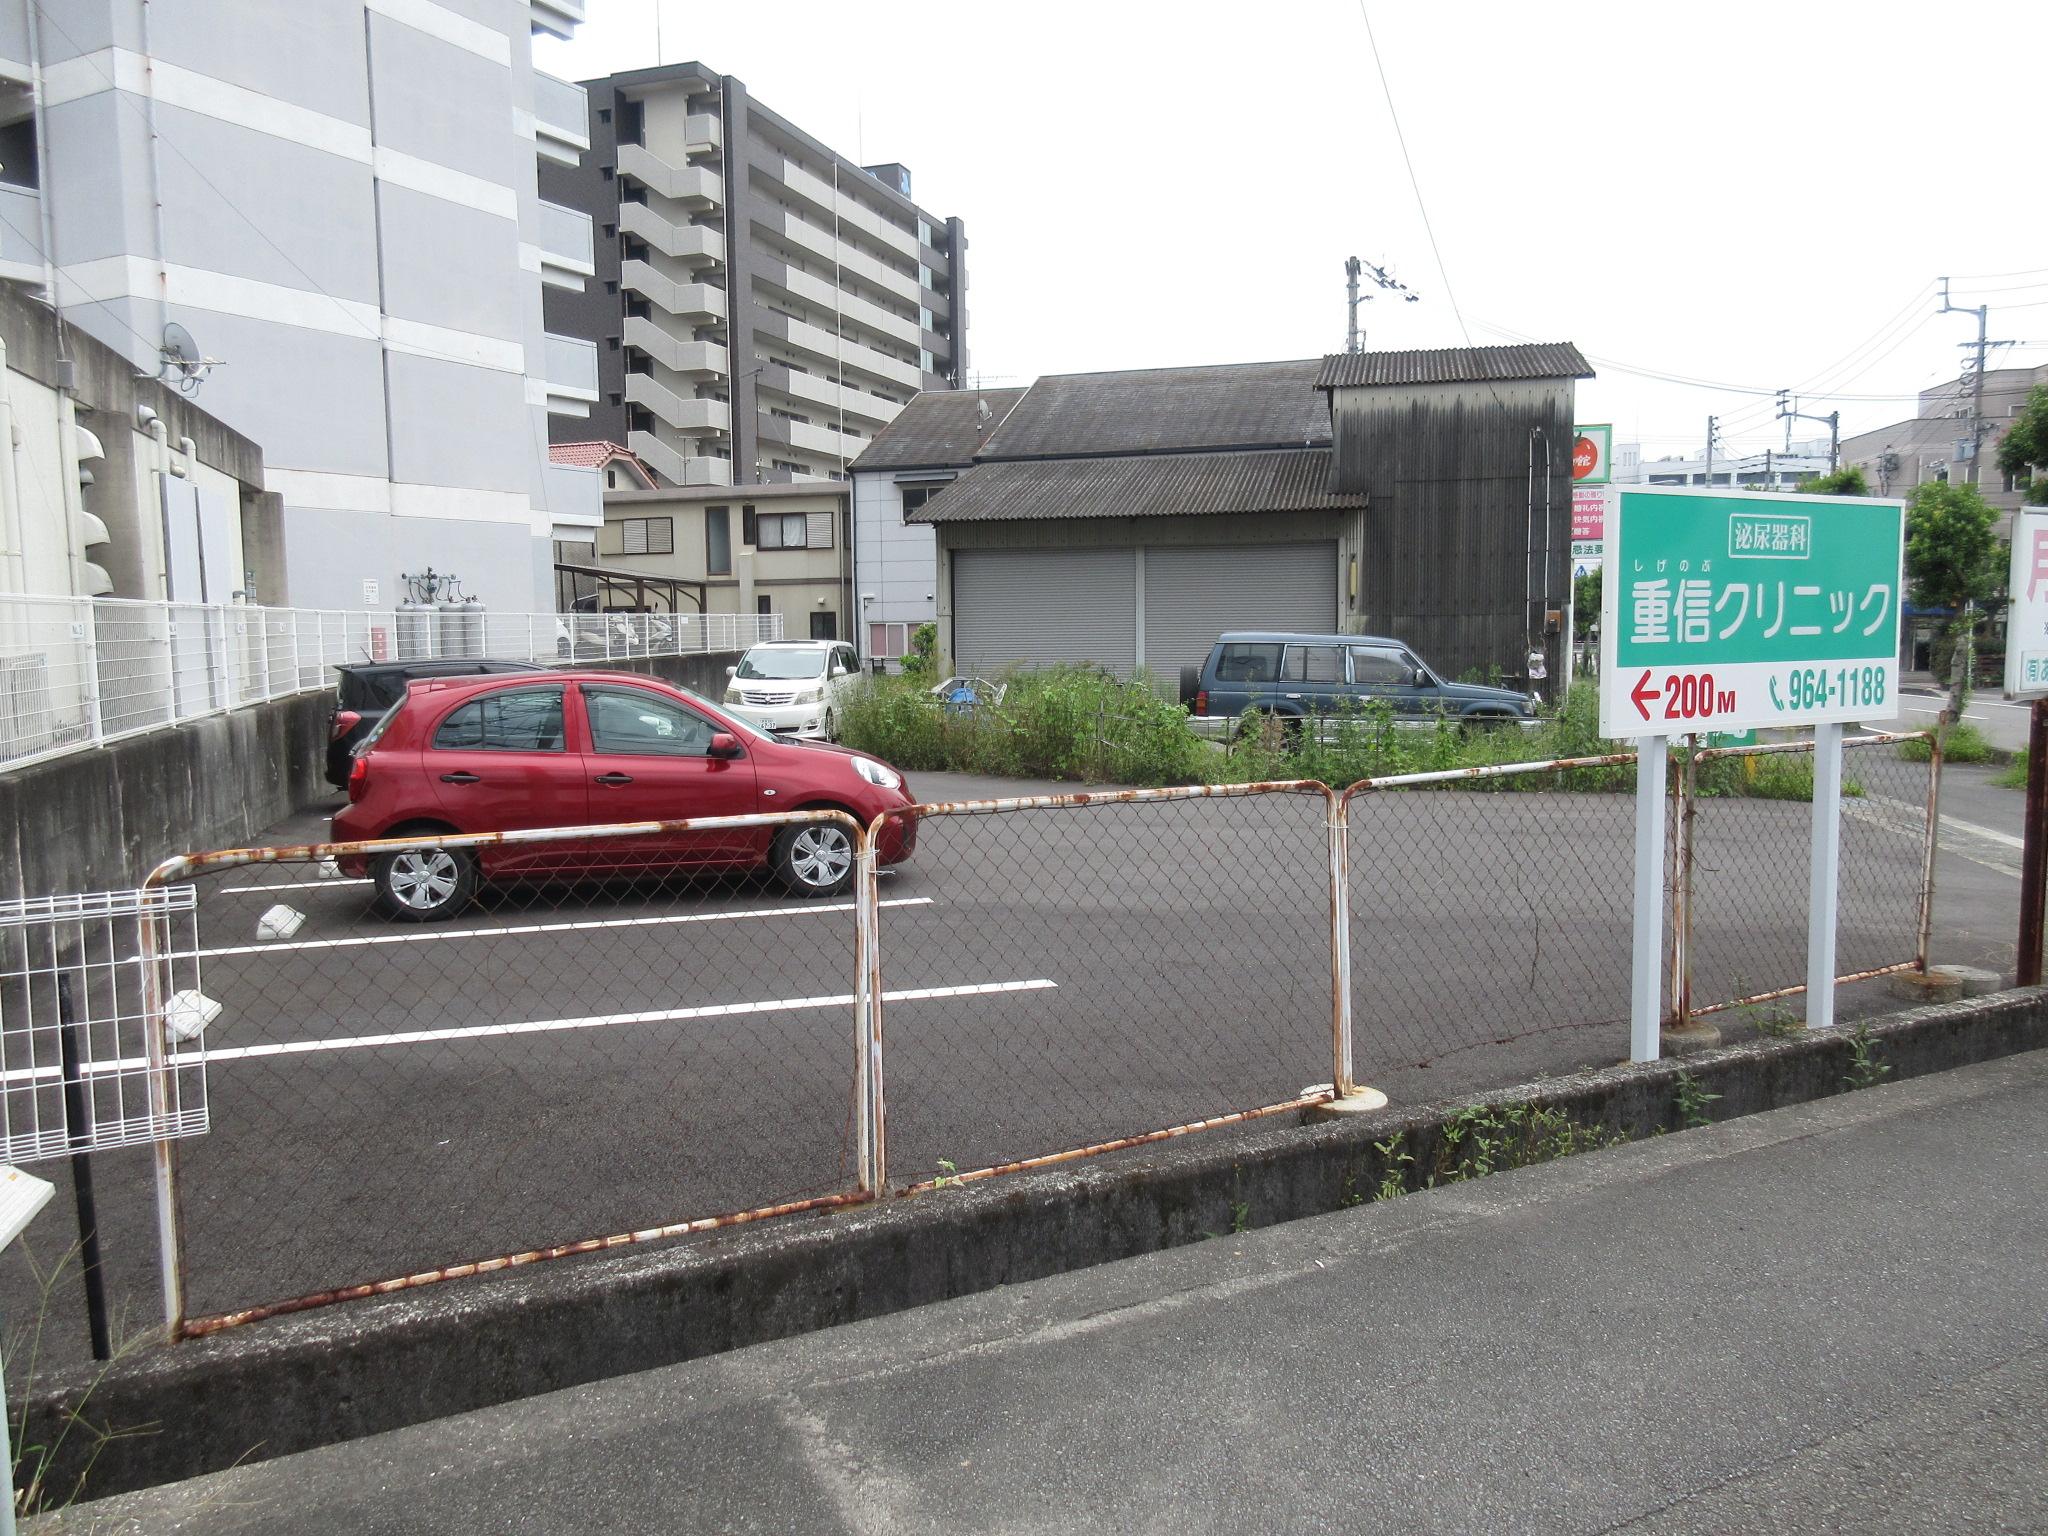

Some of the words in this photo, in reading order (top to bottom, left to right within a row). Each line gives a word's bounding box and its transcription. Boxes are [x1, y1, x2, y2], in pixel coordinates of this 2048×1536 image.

[1735, 522, 1806, 551] 泌尿器科
[1634, 559, 1711, 573] しげのぶ
[1630, 578, 1890, 643] 重信クリニック
[1789, 666, 1885, 711] 964-1188
